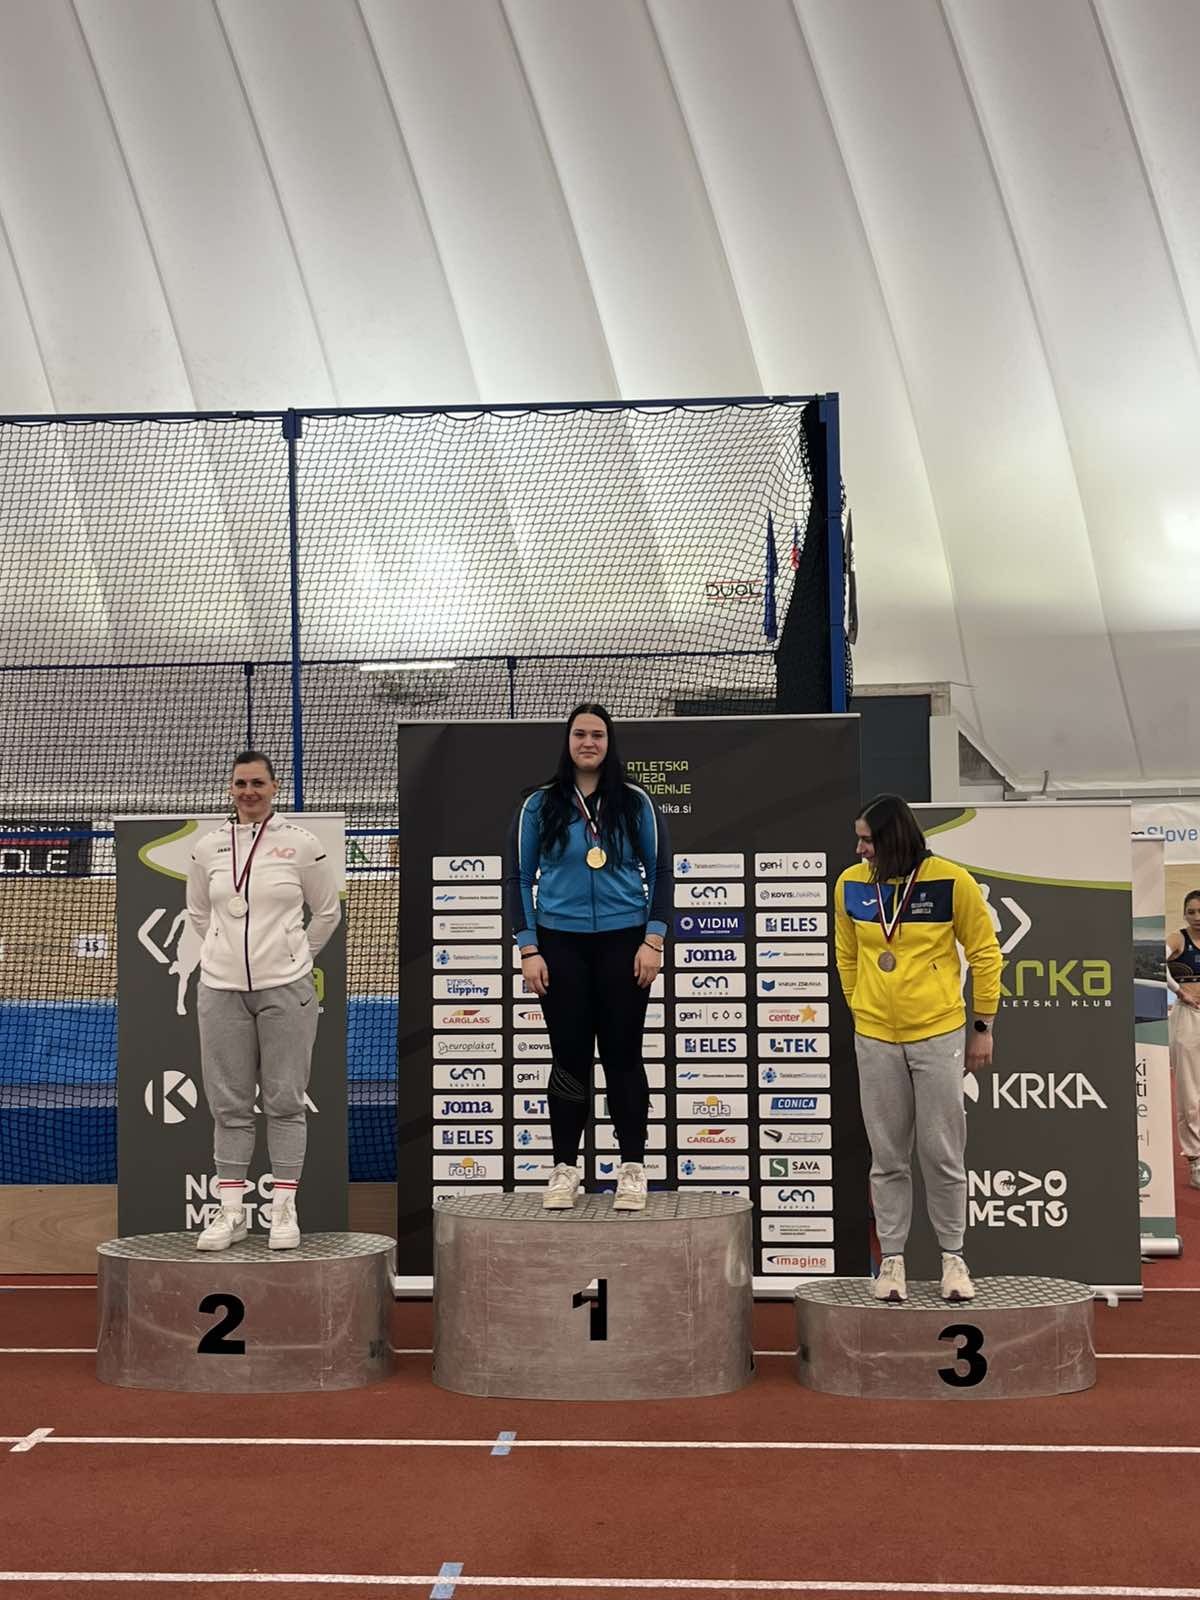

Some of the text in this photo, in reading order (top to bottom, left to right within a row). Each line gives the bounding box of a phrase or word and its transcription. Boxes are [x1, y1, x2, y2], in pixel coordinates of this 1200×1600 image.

[627, 761, 688, 771] ATLETSKA
[658, 803, 691, 813] tika.si
[697, 918, 739, 928] VIDIM
[781, 918, 817, 932] ELES
[447, 984, 490, 996] clipping
[528, 1012, 544, 1021] im
[769, 1014, 800, 1022] center
[700, 1038, 736, 1052] ELES
[992, 1073, 1108, 1109] KRKA
[693, 1100, 731, 1117] rogla
[777, 1099, 815, 1108] CONICA
[457, 1130, 493, 1144] ELES
[449, 1159, 486, 1178] rogla
[792, 1161, 820, 1170] SAVA
[776, 1256, 827, 1268] imagine
[572, 1278, 608, 1341] 1
[197, 1293, 246, 1355] 2
[937, 1323, 988, 1388] 3
